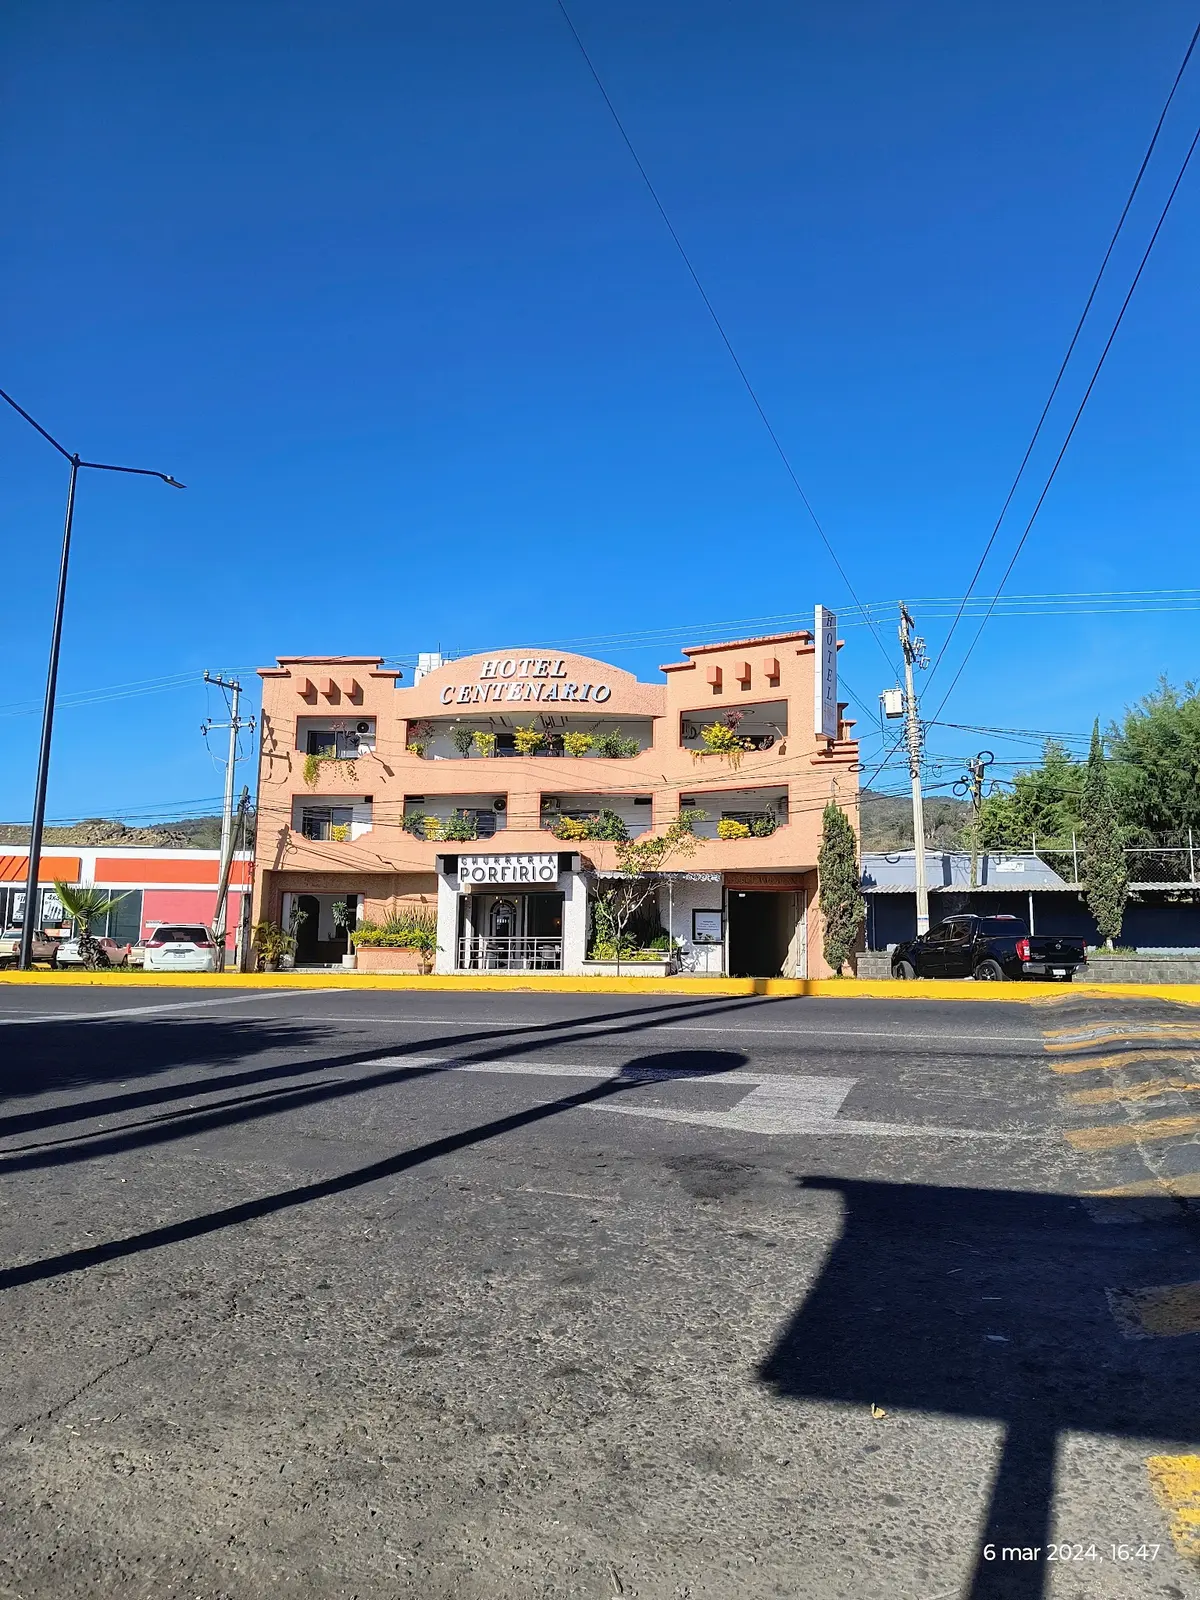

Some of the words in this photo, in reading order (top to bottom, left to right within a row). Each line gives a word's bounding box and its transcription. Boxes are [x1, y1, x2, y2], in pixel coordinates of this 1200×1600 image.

[826, 614, 834, 701] HOTEL
[479, 658, 567, 680] HOTEL
[439, 682, 612, 705] CENTENARIO
[461, 856, 554, 866] CHURRERIA
[460, 866, 554, 882] PORFIRIO
